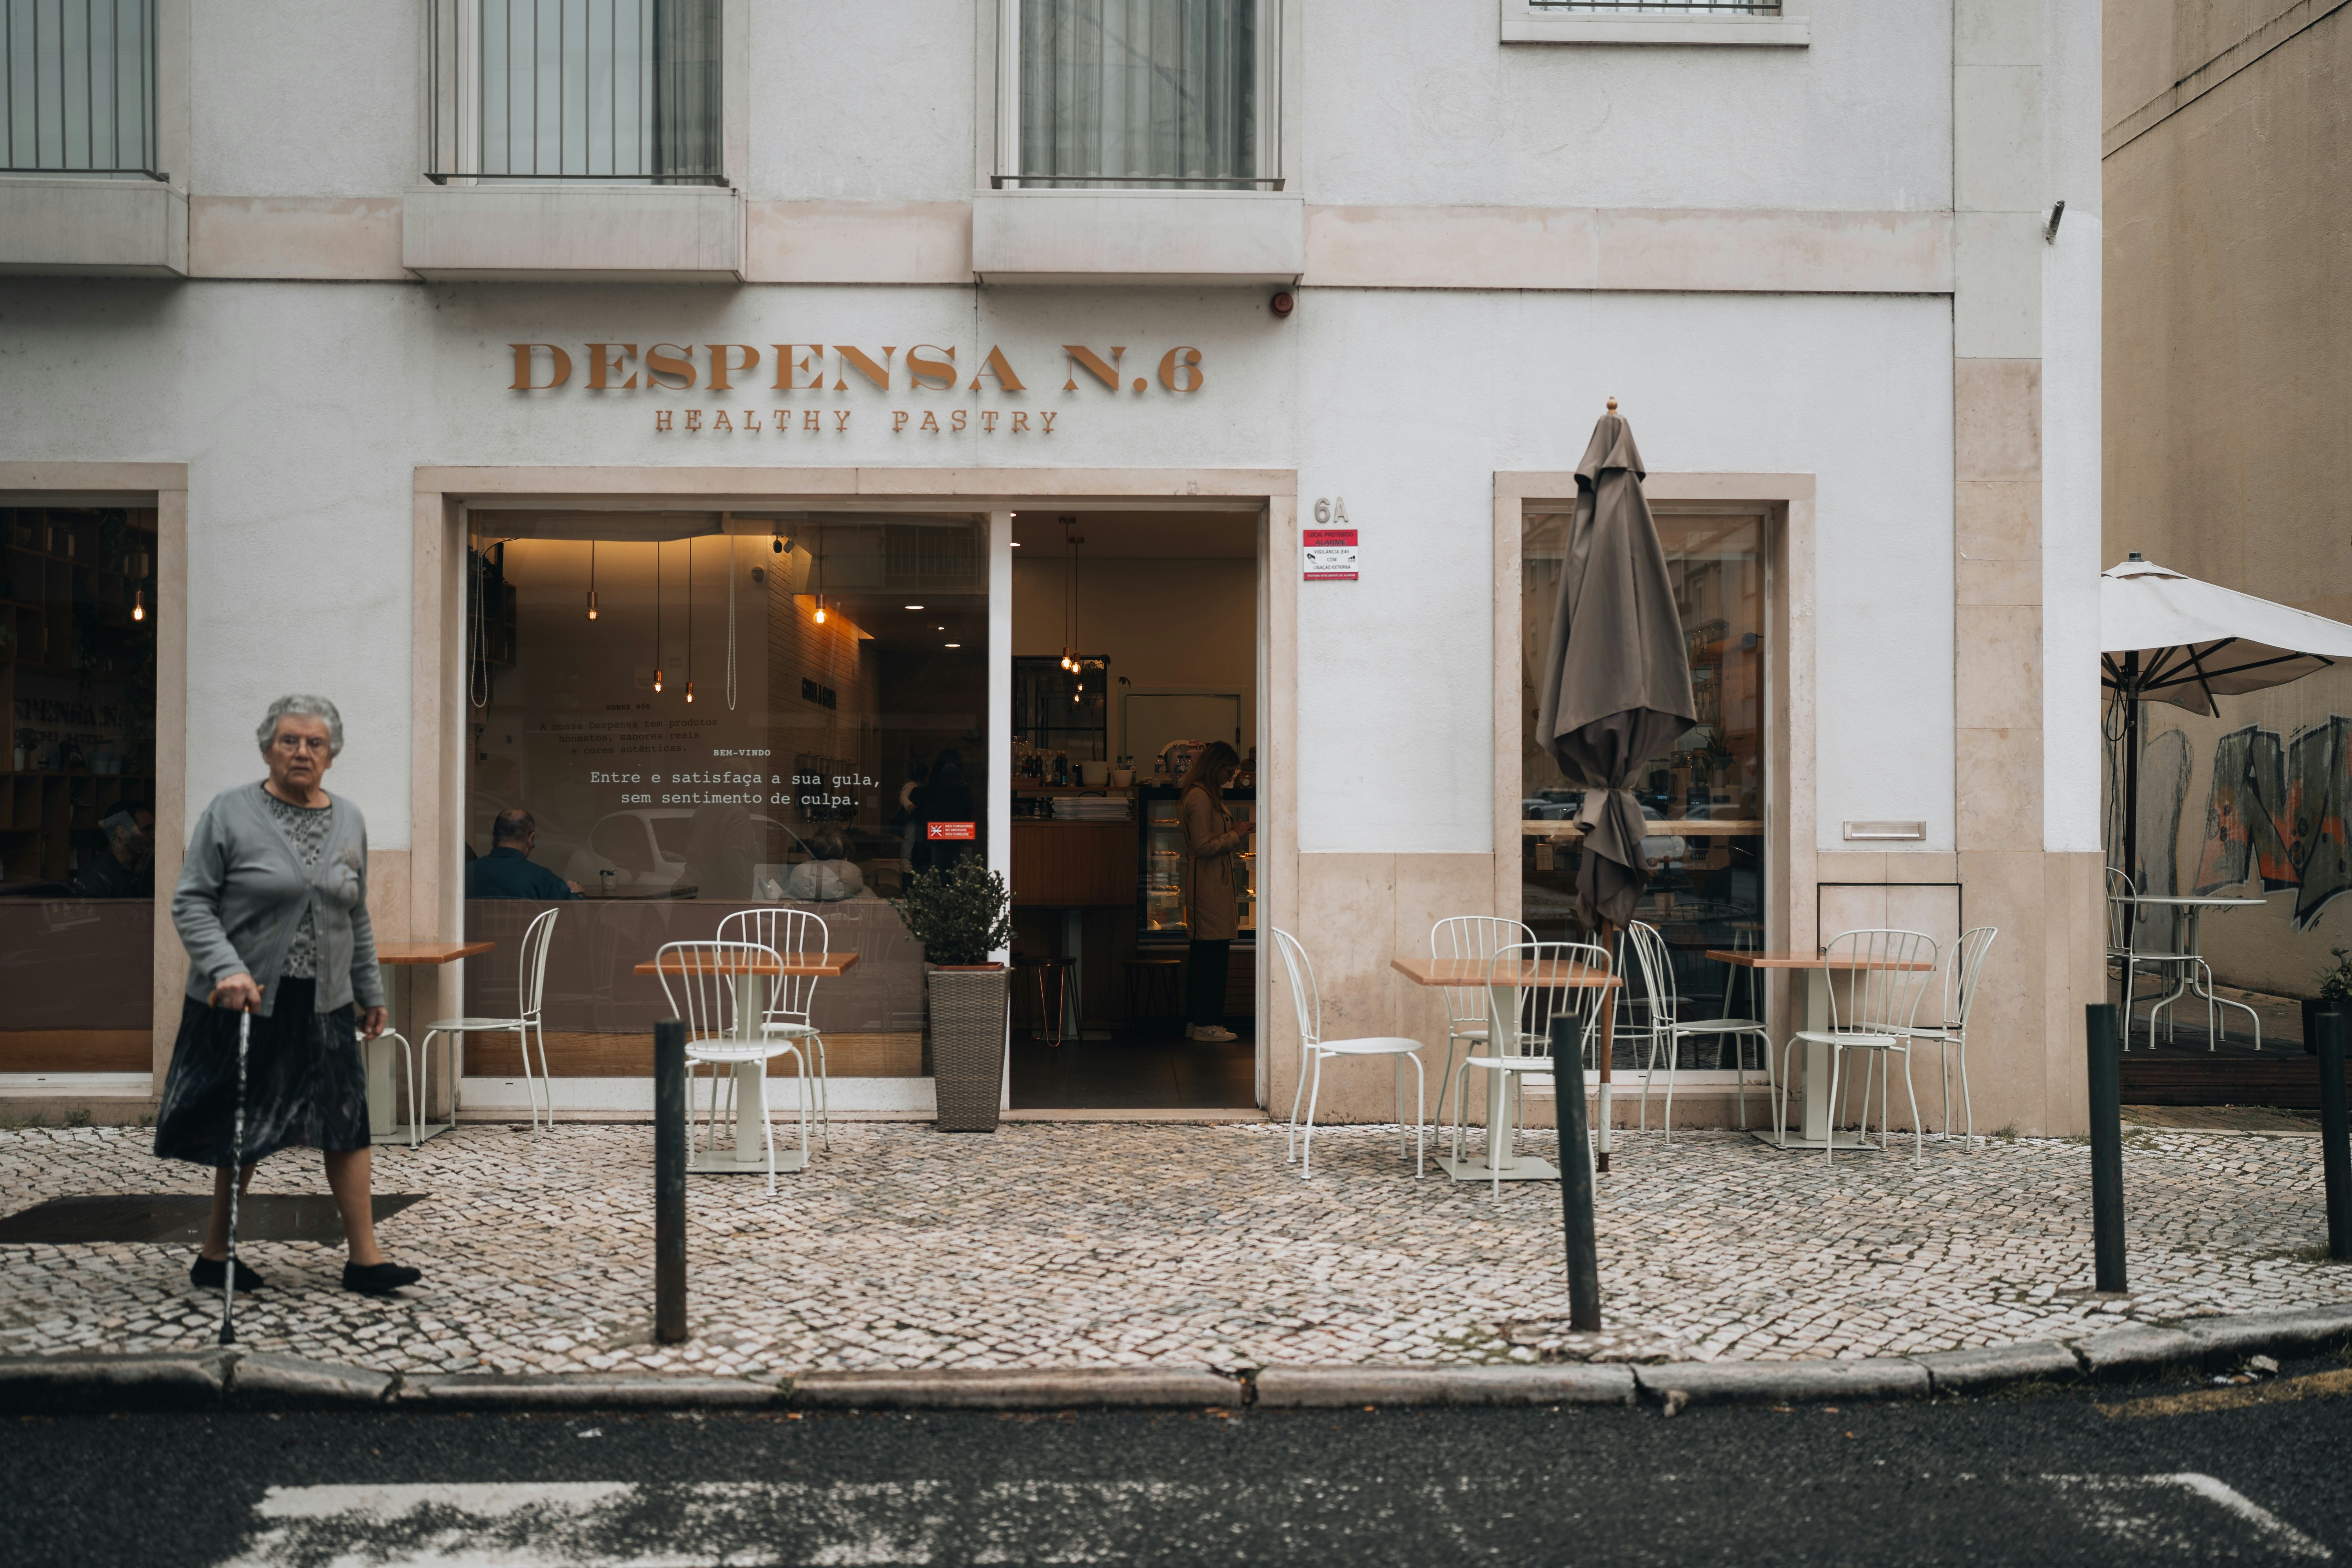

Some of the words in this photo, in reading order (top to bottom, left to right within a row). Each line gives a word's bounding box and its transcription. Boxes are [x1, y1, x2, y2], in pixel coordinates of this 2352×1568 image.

[507, 343, 1027, 392] DESPENSA
[1062, 344, 1204, 392] N.6
[655, 409, 851, 432] HEALTHY
[892, 409, 1057, 432] PASTRY
[1314, 497, 1348, 523] 6A
[589, 721, 638, 731] Despensa
[669, 718, 718, 729] produtos
[559, 734, 612, 743] honestos,
[620, 732, 663, 740] sabores
[669, 731, 700, 739] reais
[583, 746, 614, 755] cores
[620, 744, 687, 753] autênticas.
[590, 771, 641, 783] Entre
[651, 773, 661, 783] e
[672, 771, 762, 786] satisfaça
[771, 775, 781, 784] a
[792, 775, 821, 784] sua
[832, 773, 879, 788] gula,
[621, 794, 652, 803] sem
[662, 791, 762, 804] sentimento
[770, 793, 790, 804] de
[801, 793, 859, 808] culpa.
